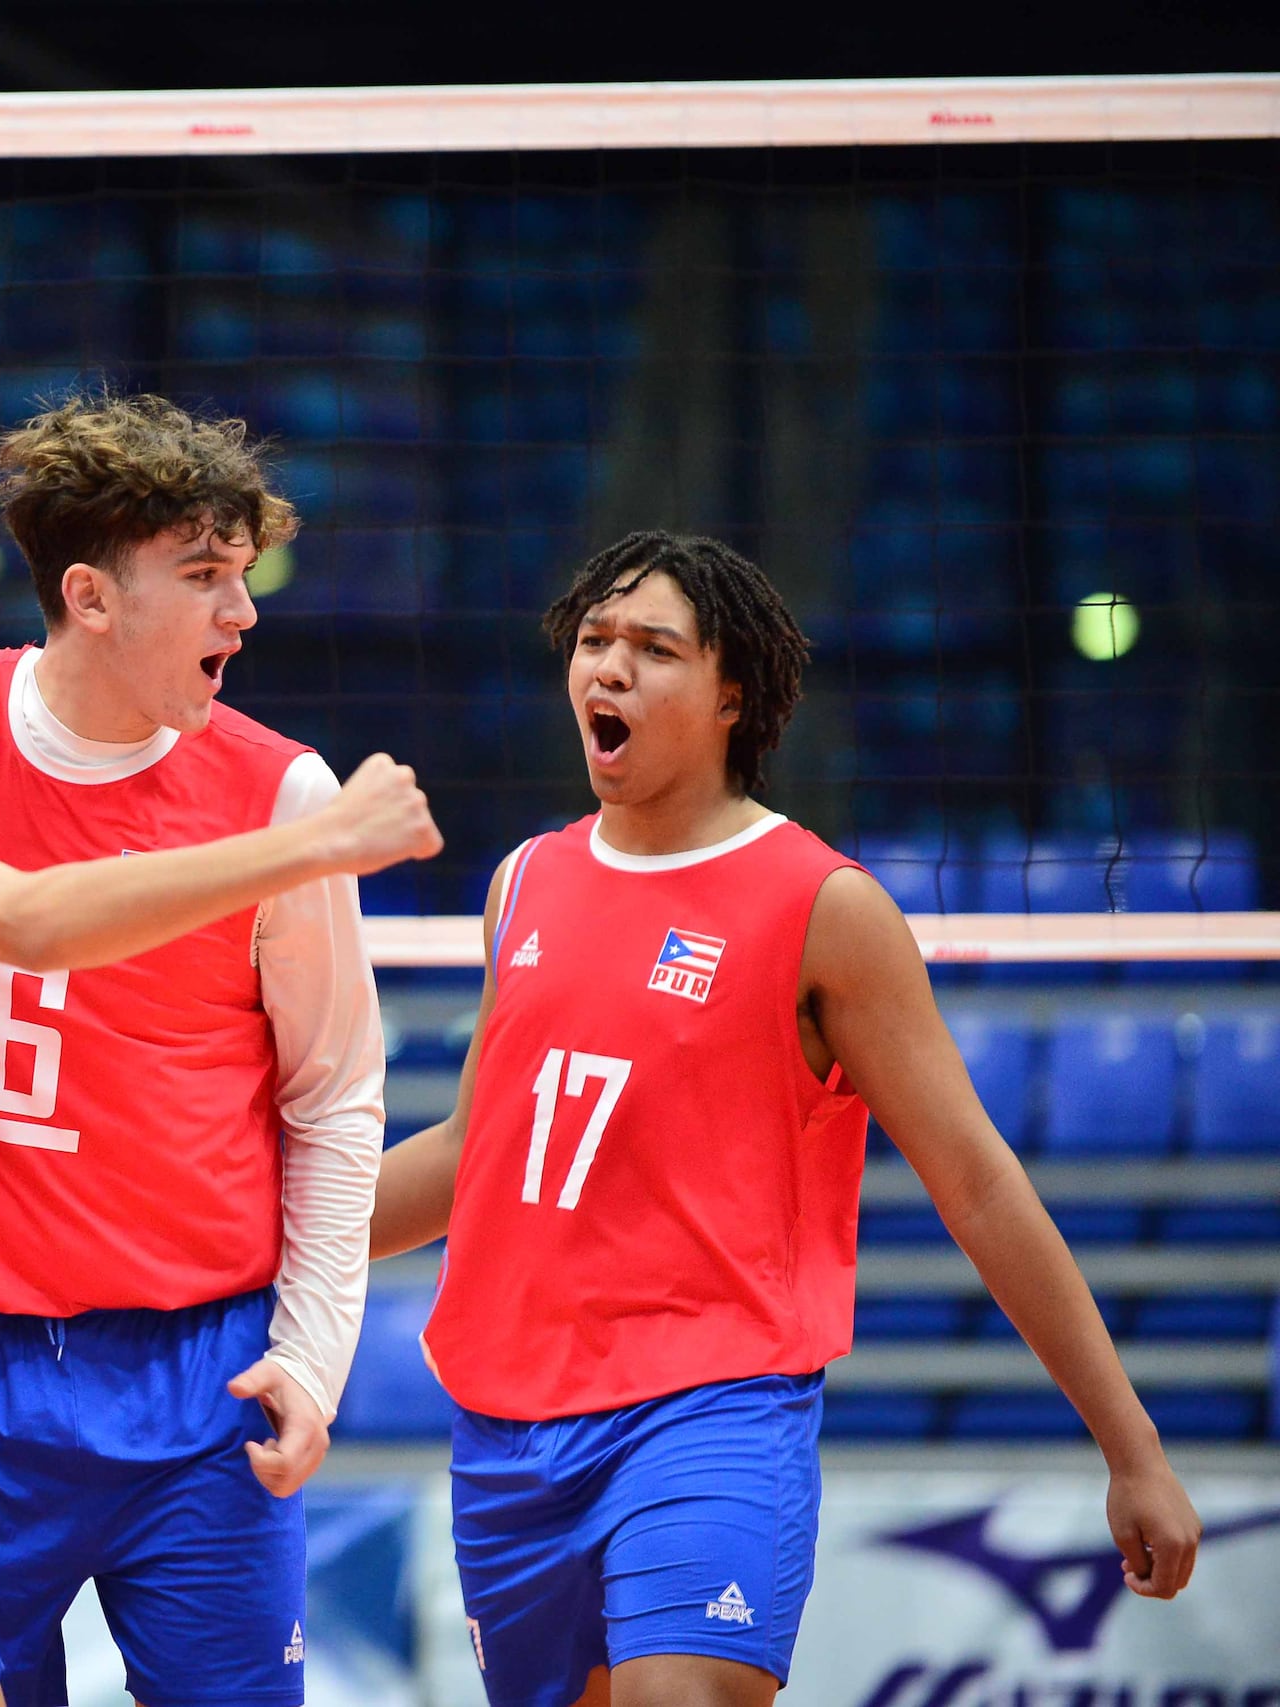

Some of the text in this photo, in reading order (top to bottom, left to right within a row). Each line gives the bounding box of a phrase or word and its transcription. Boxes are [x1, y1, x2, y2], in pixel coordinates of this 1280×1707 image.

[651, 968, 709, 998] PUR
[521, 1047, 633, 1211] 17
[705, 1600, 756, 1626] PEAK
